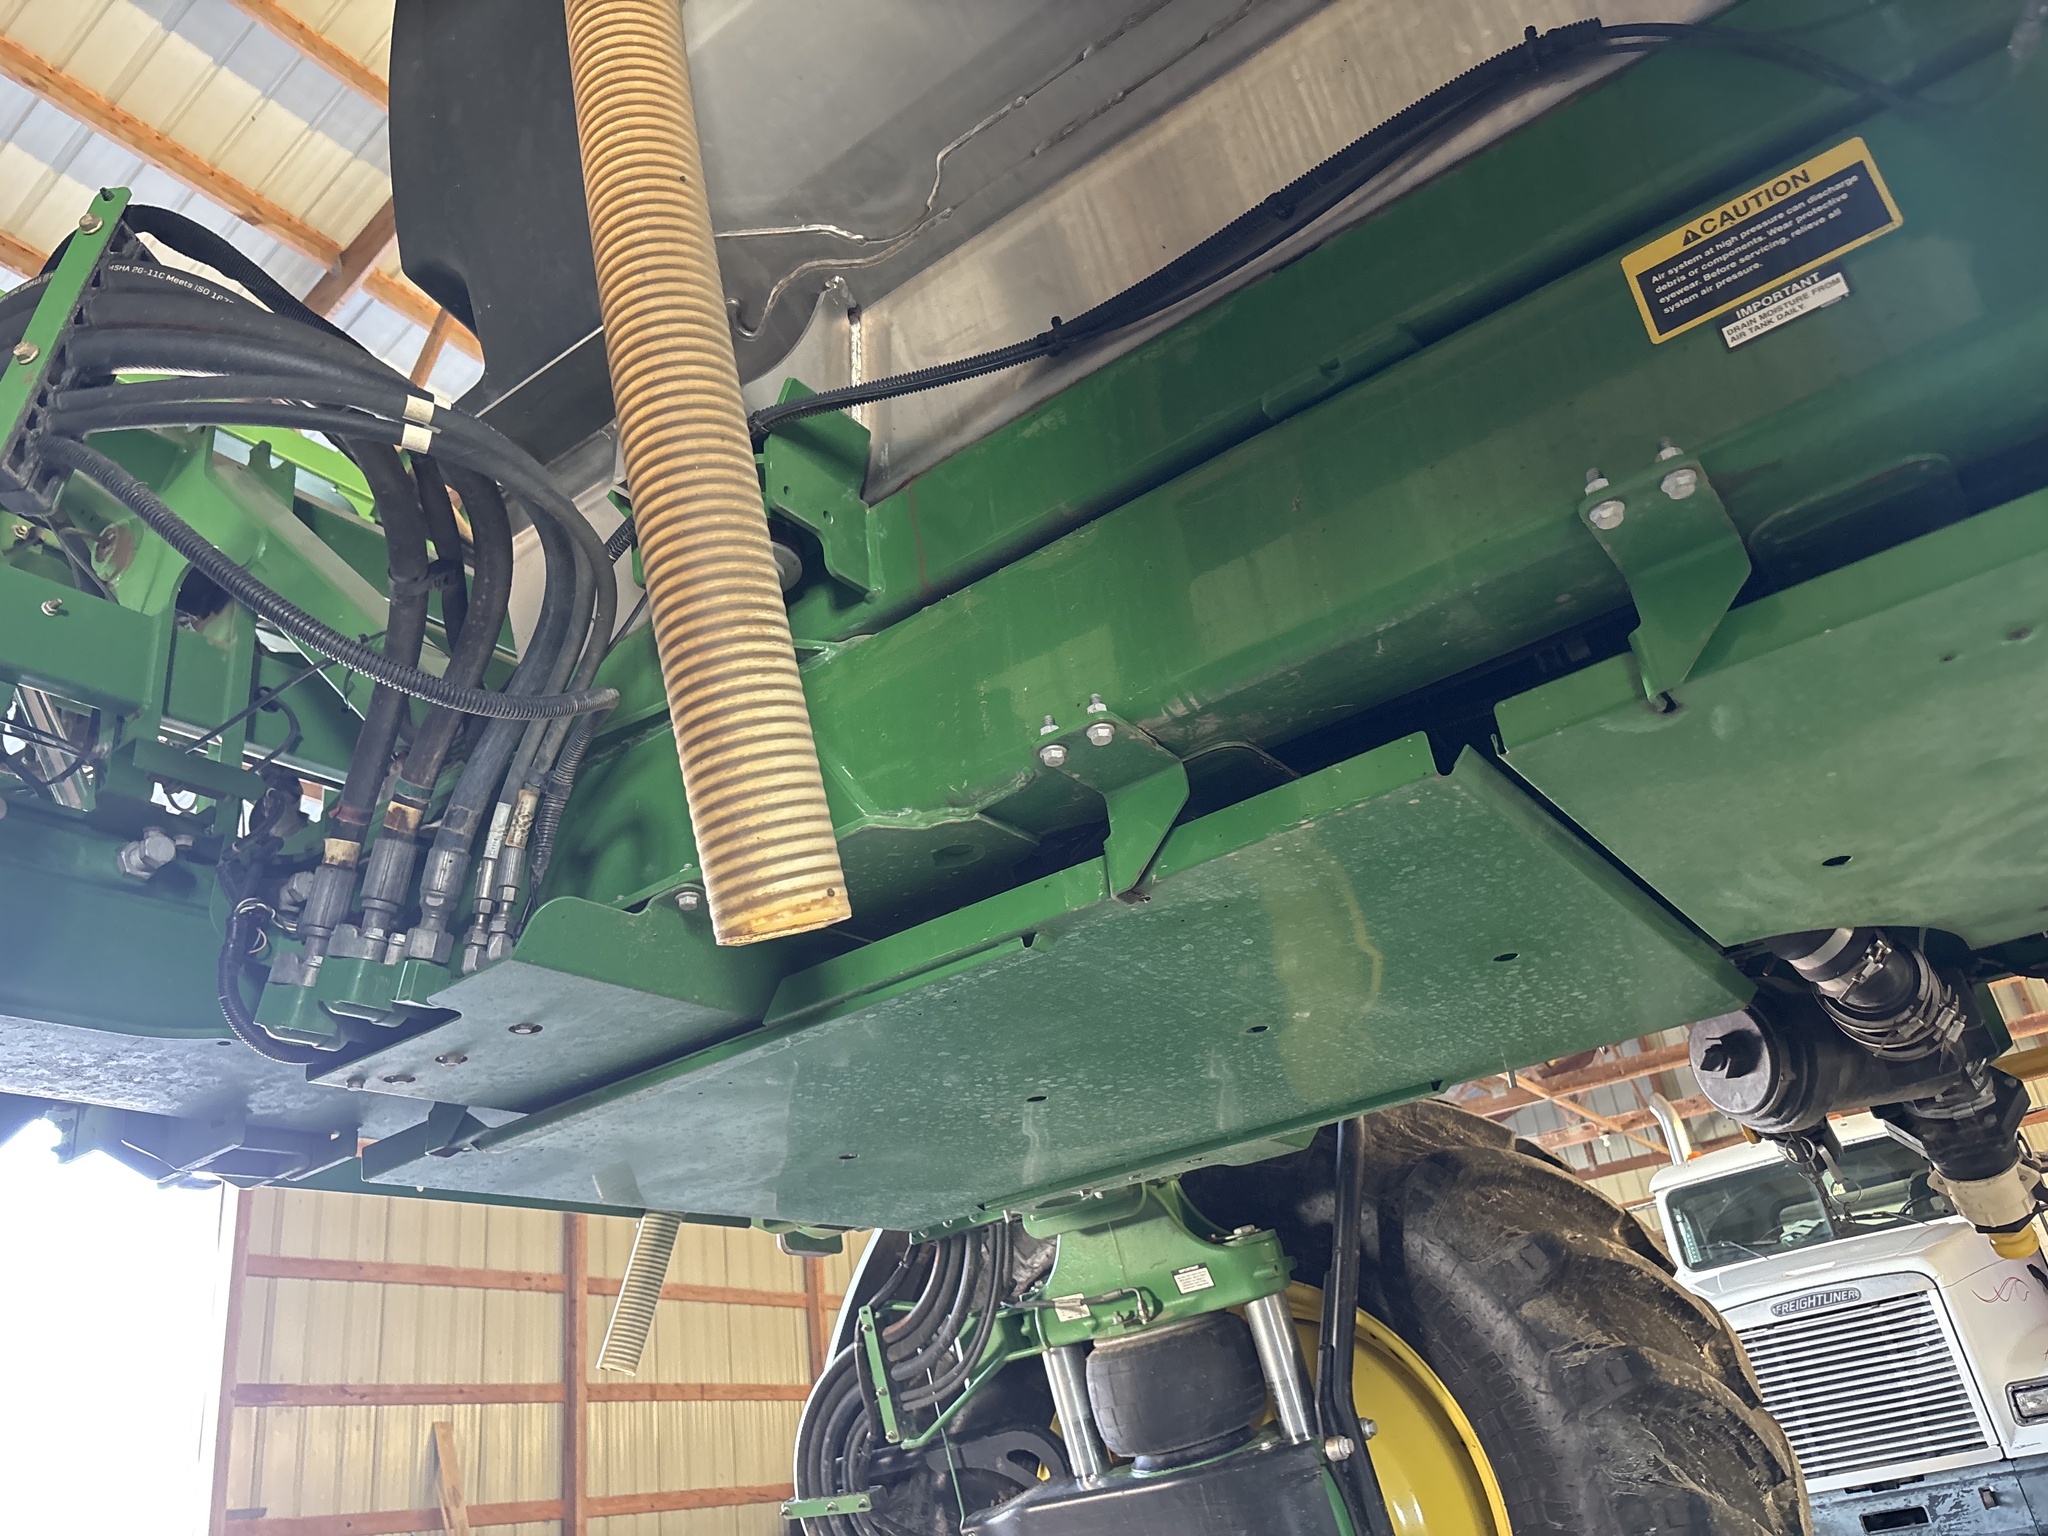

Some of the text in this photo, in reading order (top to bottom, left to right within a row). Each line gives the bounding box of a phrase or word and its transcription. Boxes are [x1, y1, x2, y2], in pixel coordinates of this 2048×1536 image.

[1652, 173, 1858, 283] Air system at high pressure can discharge
[1699, 168, 1810, 235] CAUTION
[1655, 191, 1848, 293] debris or components. Wear protective
[1658, 207, 1841, 303] eyewear. Before servicing, relieve all
[165, 274, 192, 288] Meets
[194, 284, 210, 295] ISO
[1662, 261, 1762, 314] system air pressure.
[1726, 317, 1756, 336] DRAIN
[1758, 292, 1809, 320] MOISTURE
[1811, 277, 1840, 295] FROM
[1735, 272, 1821, 319] IMPORTANT
[1731, 303, 1804, 342] AIR TANK DAILY
[1776, 1290, 1854, 1314] FREIGHTLINER
